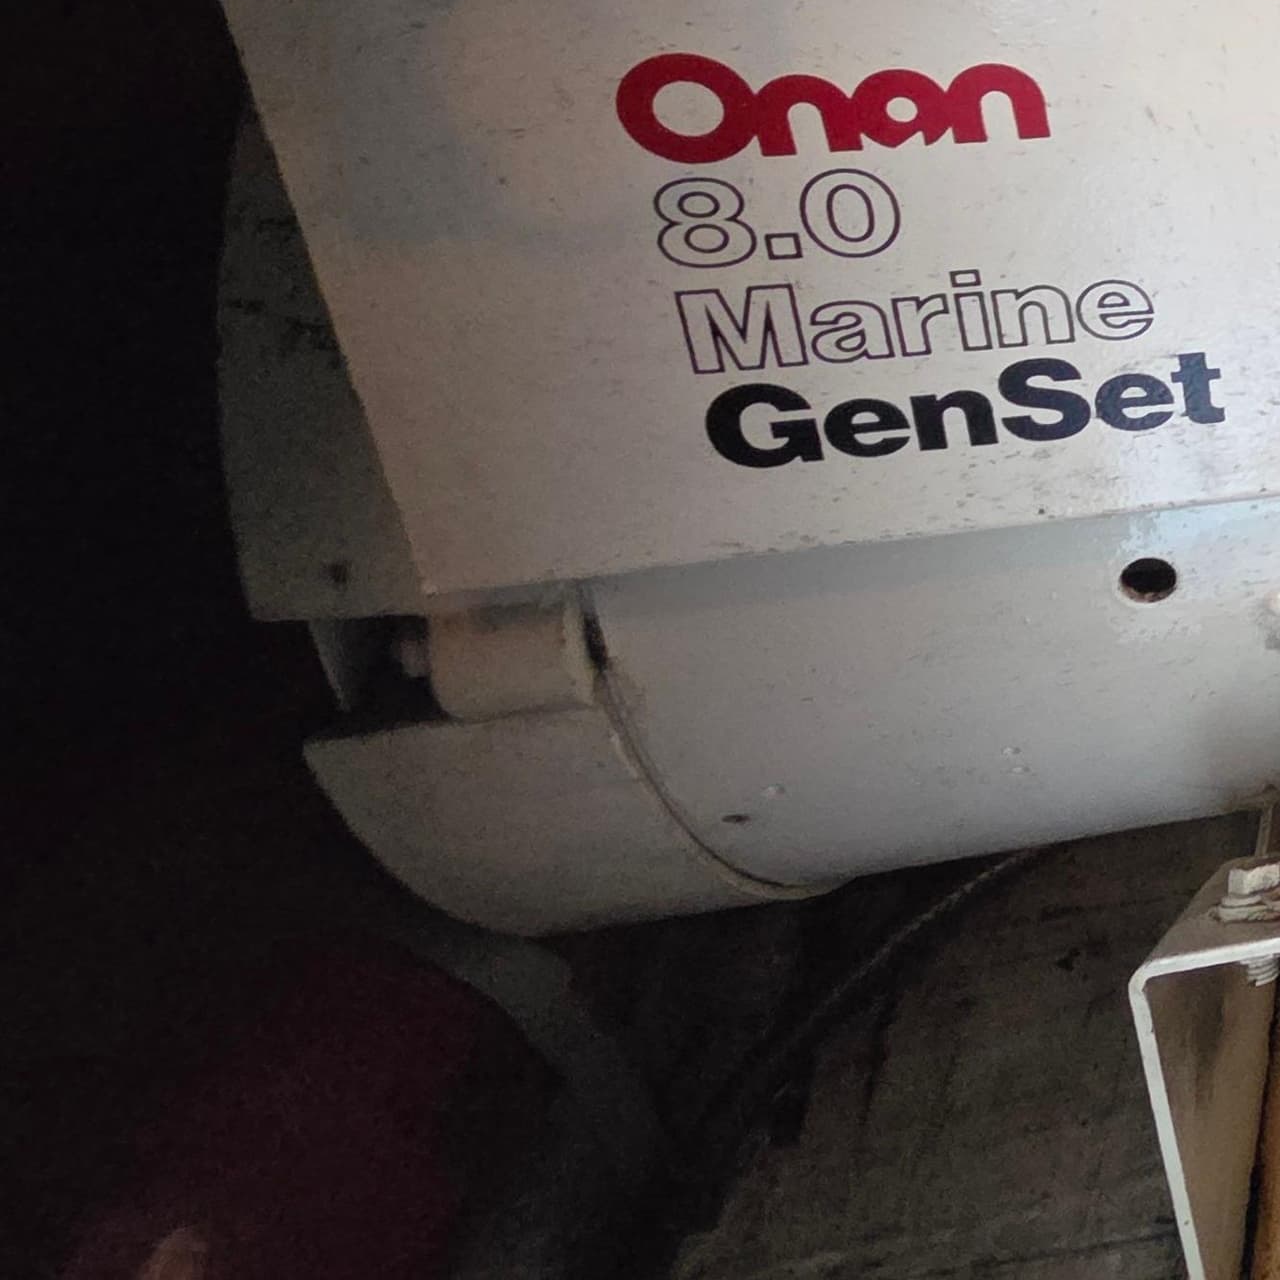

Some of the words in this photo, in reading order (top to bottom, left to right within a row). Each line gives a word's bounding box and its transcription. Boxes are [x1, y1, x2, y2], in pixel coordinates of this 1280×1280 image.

[616, 53, 1050, 164] Onan
[653, 167, 901, 269] 8.0
[675, 269, 1155, 375] Marine
[704, 351, 1226, 469] GenSet
